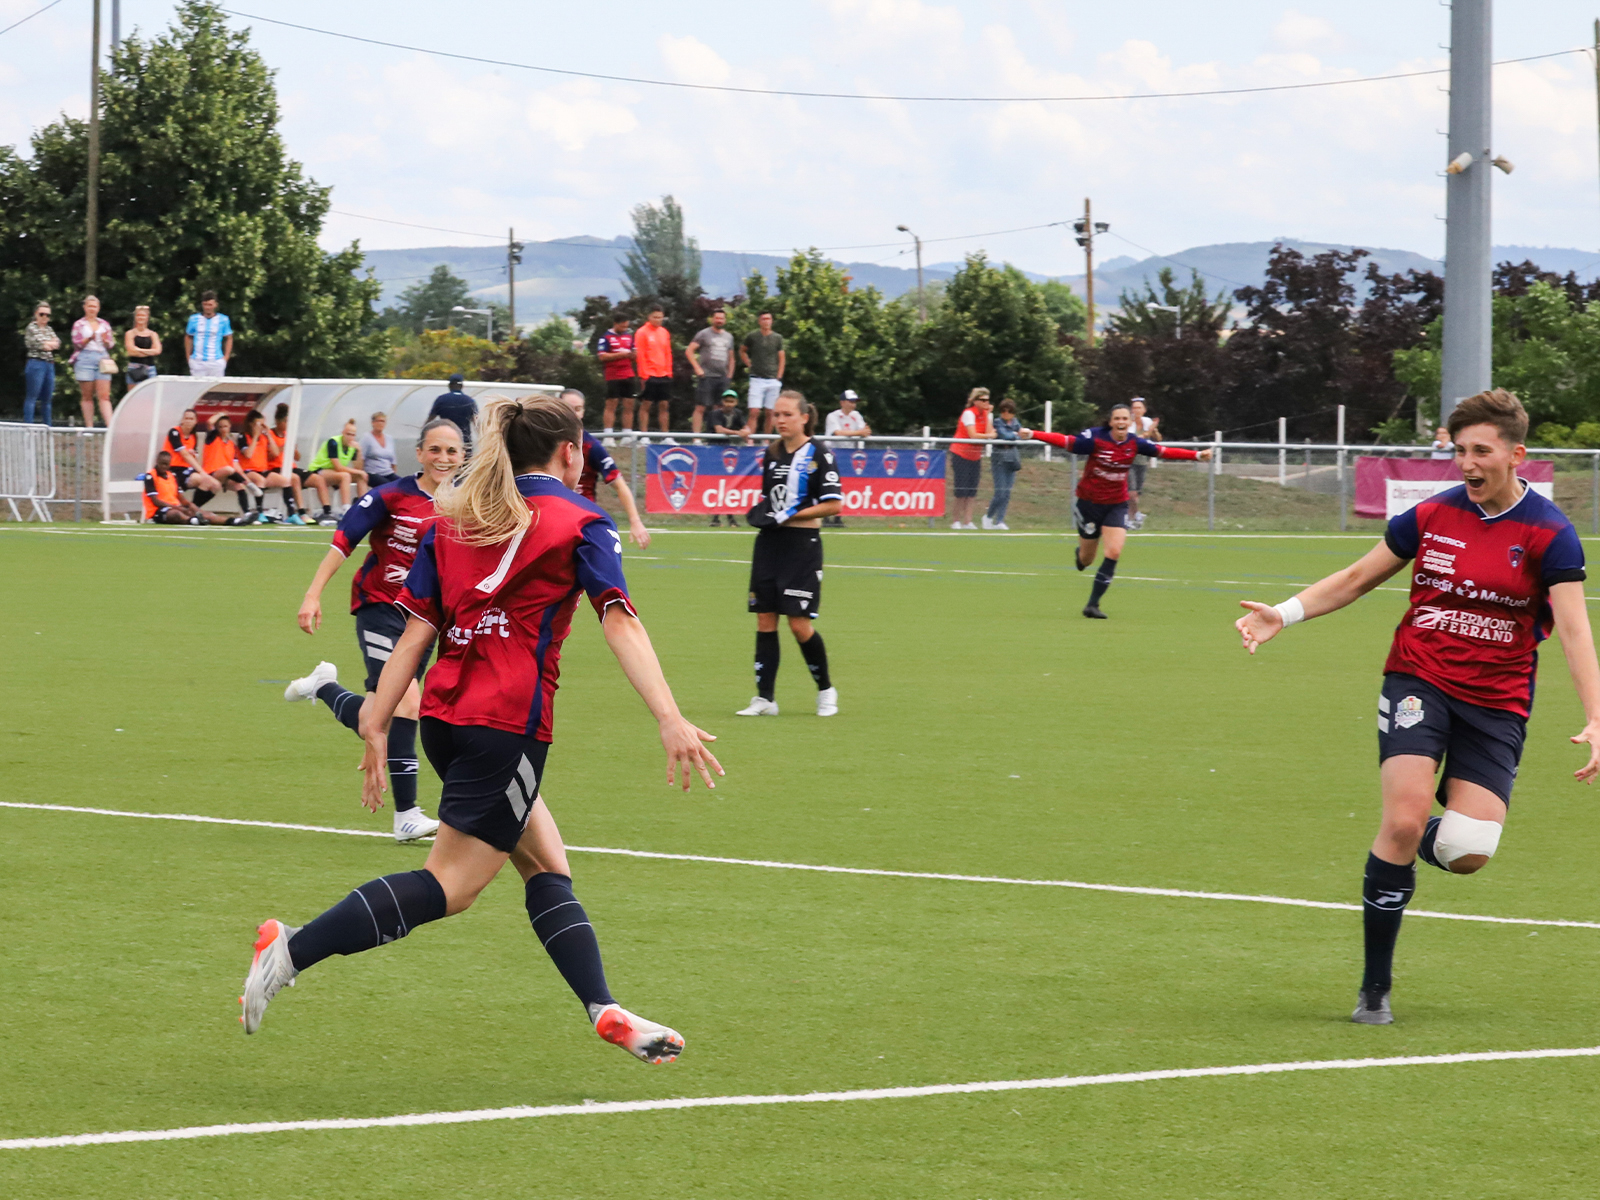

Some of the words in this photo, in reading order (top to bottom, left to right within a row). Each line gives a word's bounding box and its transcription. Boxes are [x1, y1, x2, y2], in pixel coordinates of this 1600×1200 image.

[1433, 534, 1467, 549] PATRICK
[1414, 573, 1454, 593] Crédit
[1480, 589, 1530, 607] Mutuel
[1438, 619, 1514, 643] FERRAND
[1440, 610, 1516, 631] CLERMONT
